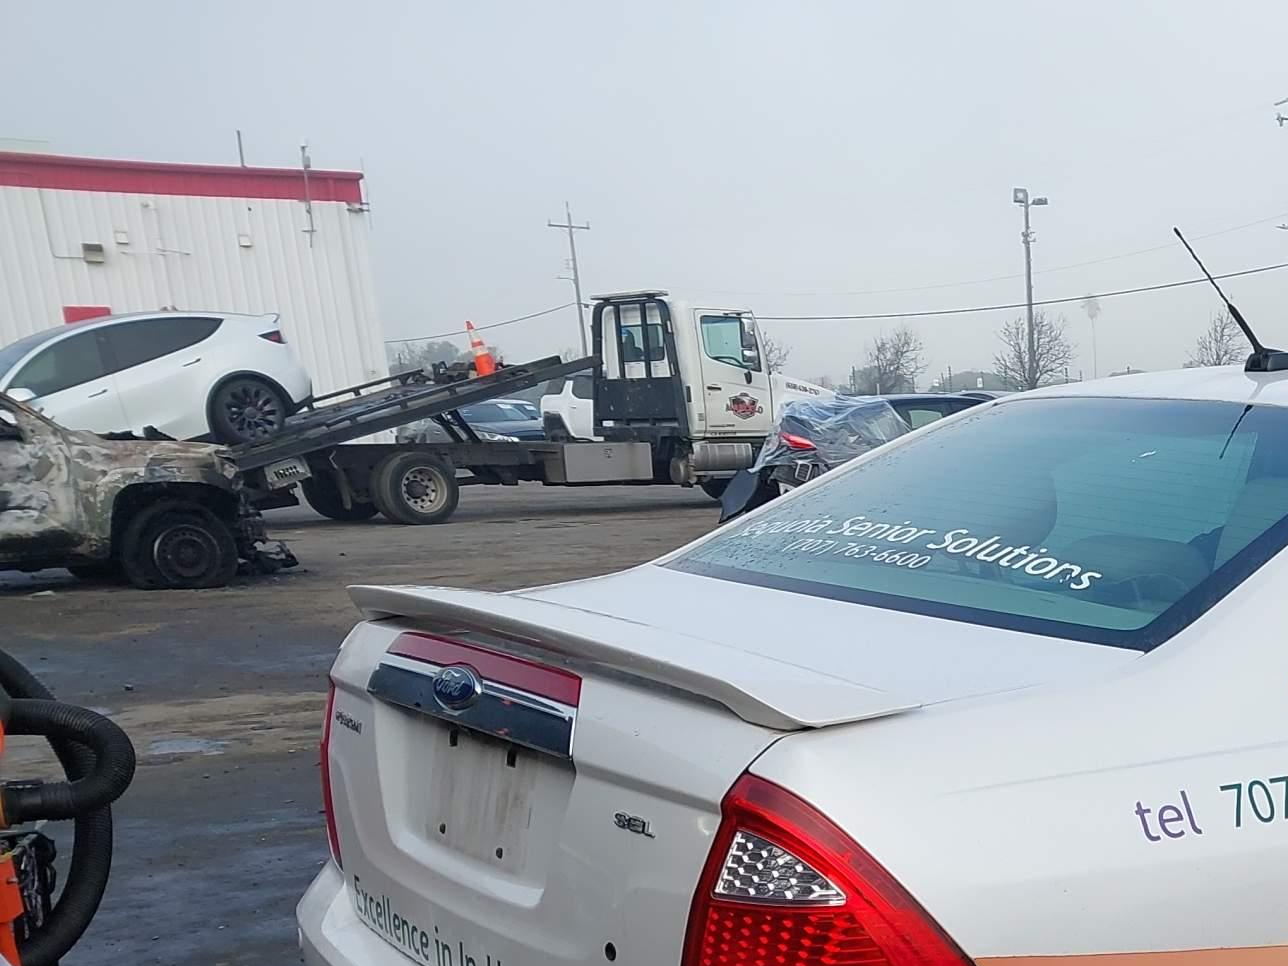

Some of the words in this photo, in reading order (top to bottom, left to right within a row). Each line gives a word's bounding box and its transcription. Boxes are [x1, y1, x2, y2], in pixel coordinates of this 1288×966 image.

[728, 514, 833, 539] Sequoia
[826, 515, 935, 543] Senior
[925, 528, 1102, 590] Solutions
[781, 537, 840, 556] (707)
[833, 542, 932, 570] 763-6600
[614, 811, 656, 839] SEL
[1135, 790, 1203, 842] tel
[353, 875, 429, 960] Excellence
